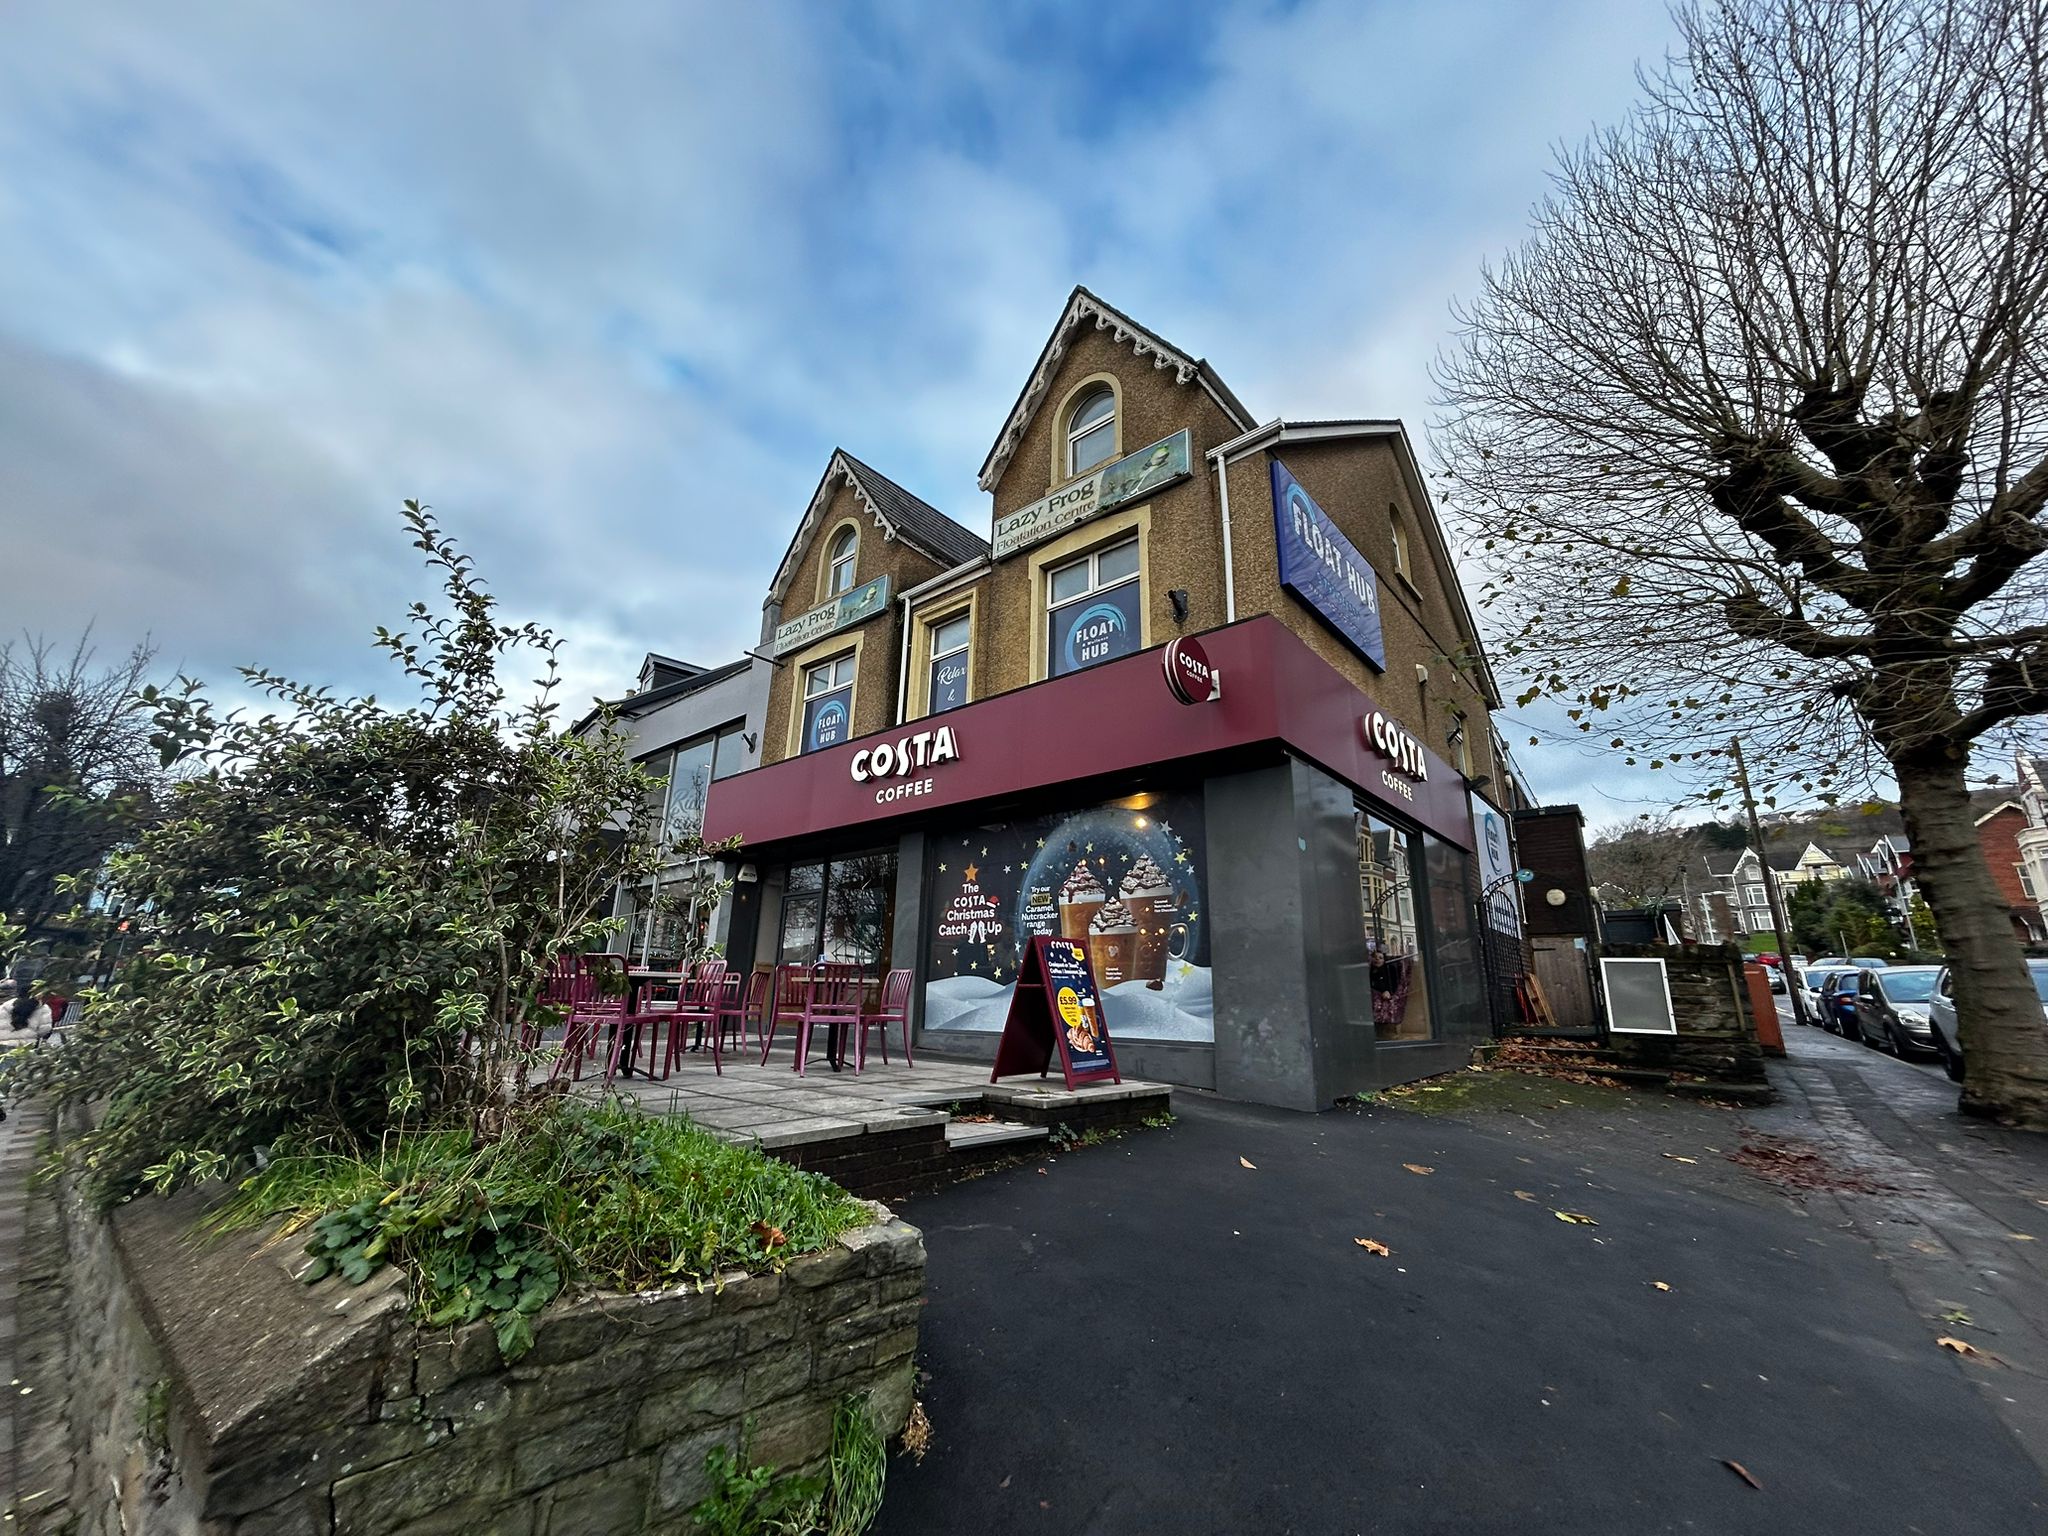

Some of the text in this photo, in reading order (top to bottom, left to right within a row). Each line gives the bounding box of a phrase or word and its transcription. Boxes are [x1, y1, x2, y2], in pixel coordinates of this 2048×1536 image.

[997, 480, 1095, 537] Lazy Frog
[996, 520, 1052, 551] Floatation
[1291, 501, 1344, 579] FLOAT
[1345, 560, 1375, 614] HUB
[778, 604, 836, 640] Lazy Frog
[1075, 619, 1115, 643] FLOAT
[1081, 642, 1109, 661] HUB
[1179, 652, 1209, 678] COSTA
[937, 666, 967, 685] Relax
[818, 714, 841, 729] FLOAT
[819, 730, 836, 743] HUB
[850, 726, 959, 782] COSTA
[1364, 711, 1428, 782] COSTA
[875, 778, 933, 804] COFFEE
[1381, 770, 1413, 801] COFFEE
[962, 884, 979, 894] The
[1031, 886, 1040, 895] Try
[954, 895, 986, 908] COSTA
[1025, 904, 1054, 913] Caramel
[946, 907, 995, 921] Christmas
[1021, 911, 1058, 921] Nutcracker
[938, 921, 1003, 937] Catch Up
[1026, 920, 1046, 930] range
[1033, 927, 1053, 937] today
[1060, 996, 1078, 1005] £5.99
